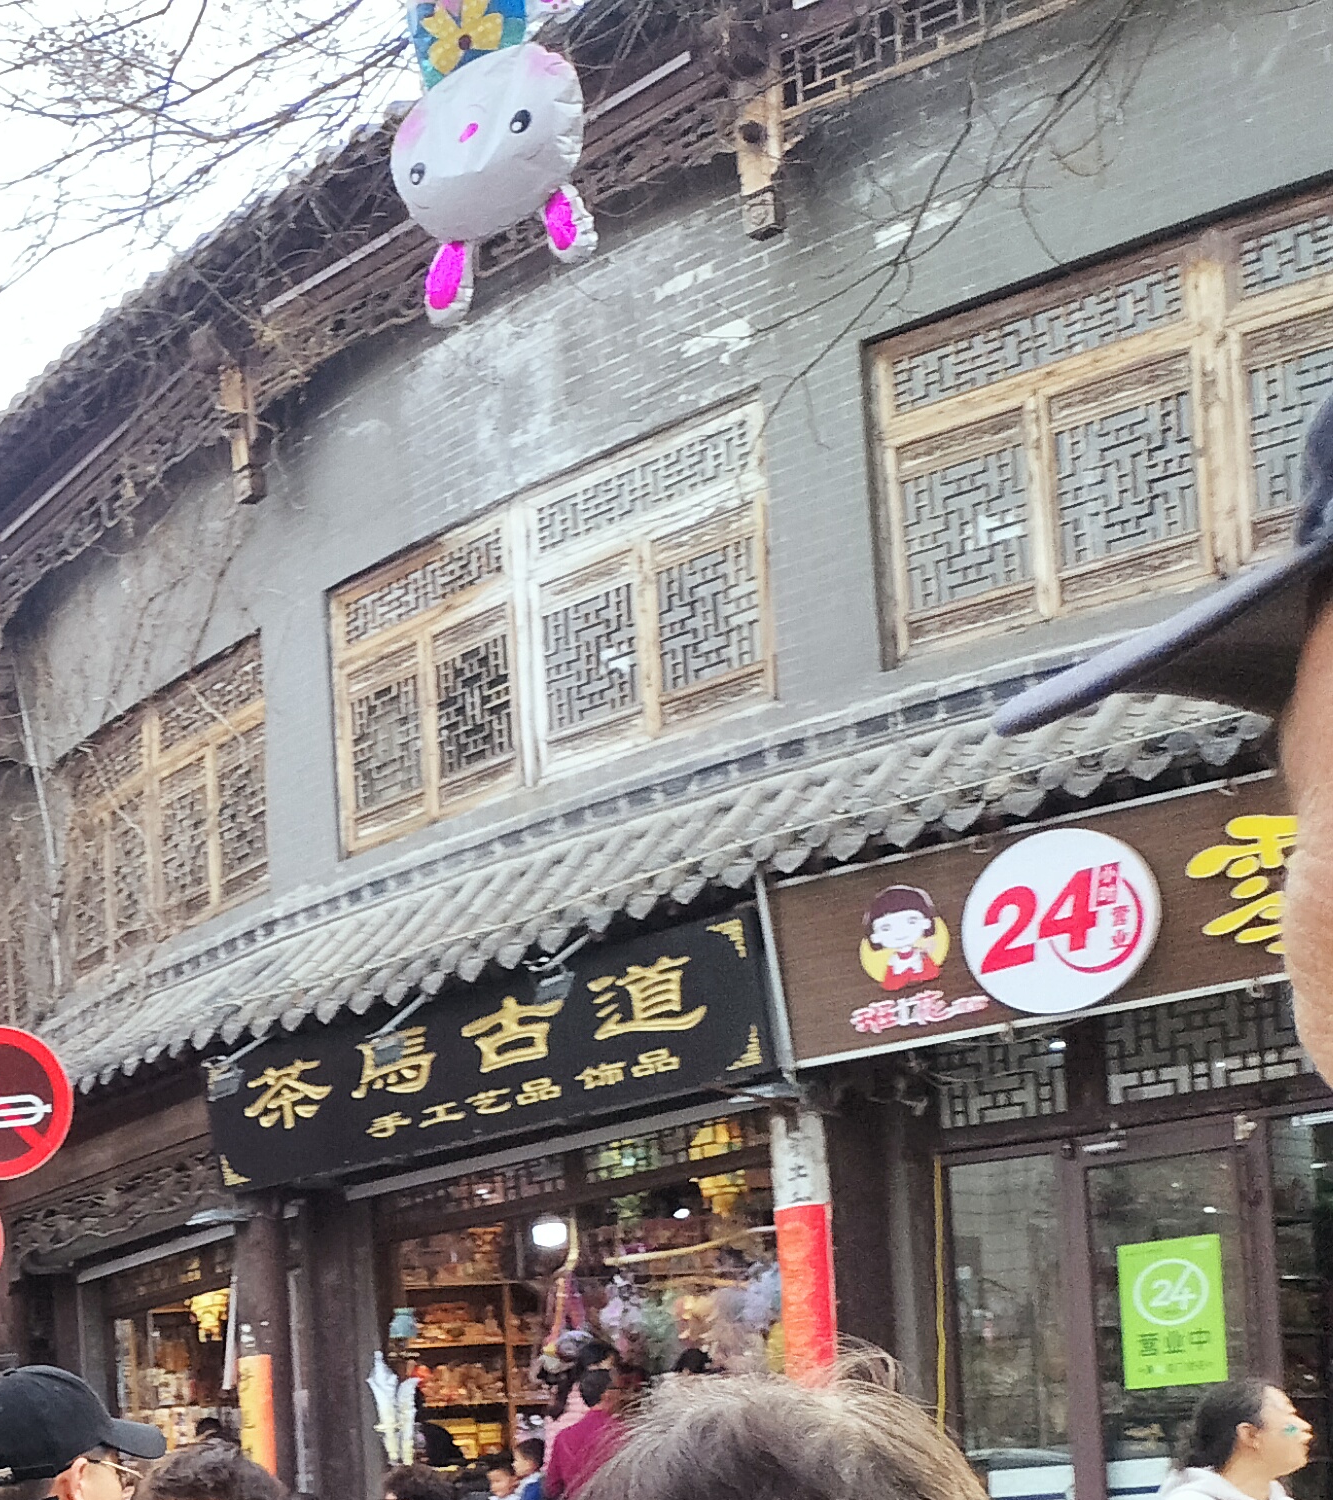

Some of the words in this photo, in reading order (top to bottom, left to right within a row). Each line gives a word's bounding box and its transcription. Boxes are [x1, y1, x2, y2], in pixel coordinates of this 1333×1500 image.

[980, 862, 1098, 975] 24
[365, 1078, 563, 1139] 手工艺品
[574, 1047, 681, 1091] 饰品
[1149, 1264, 1197, 1311] 24
